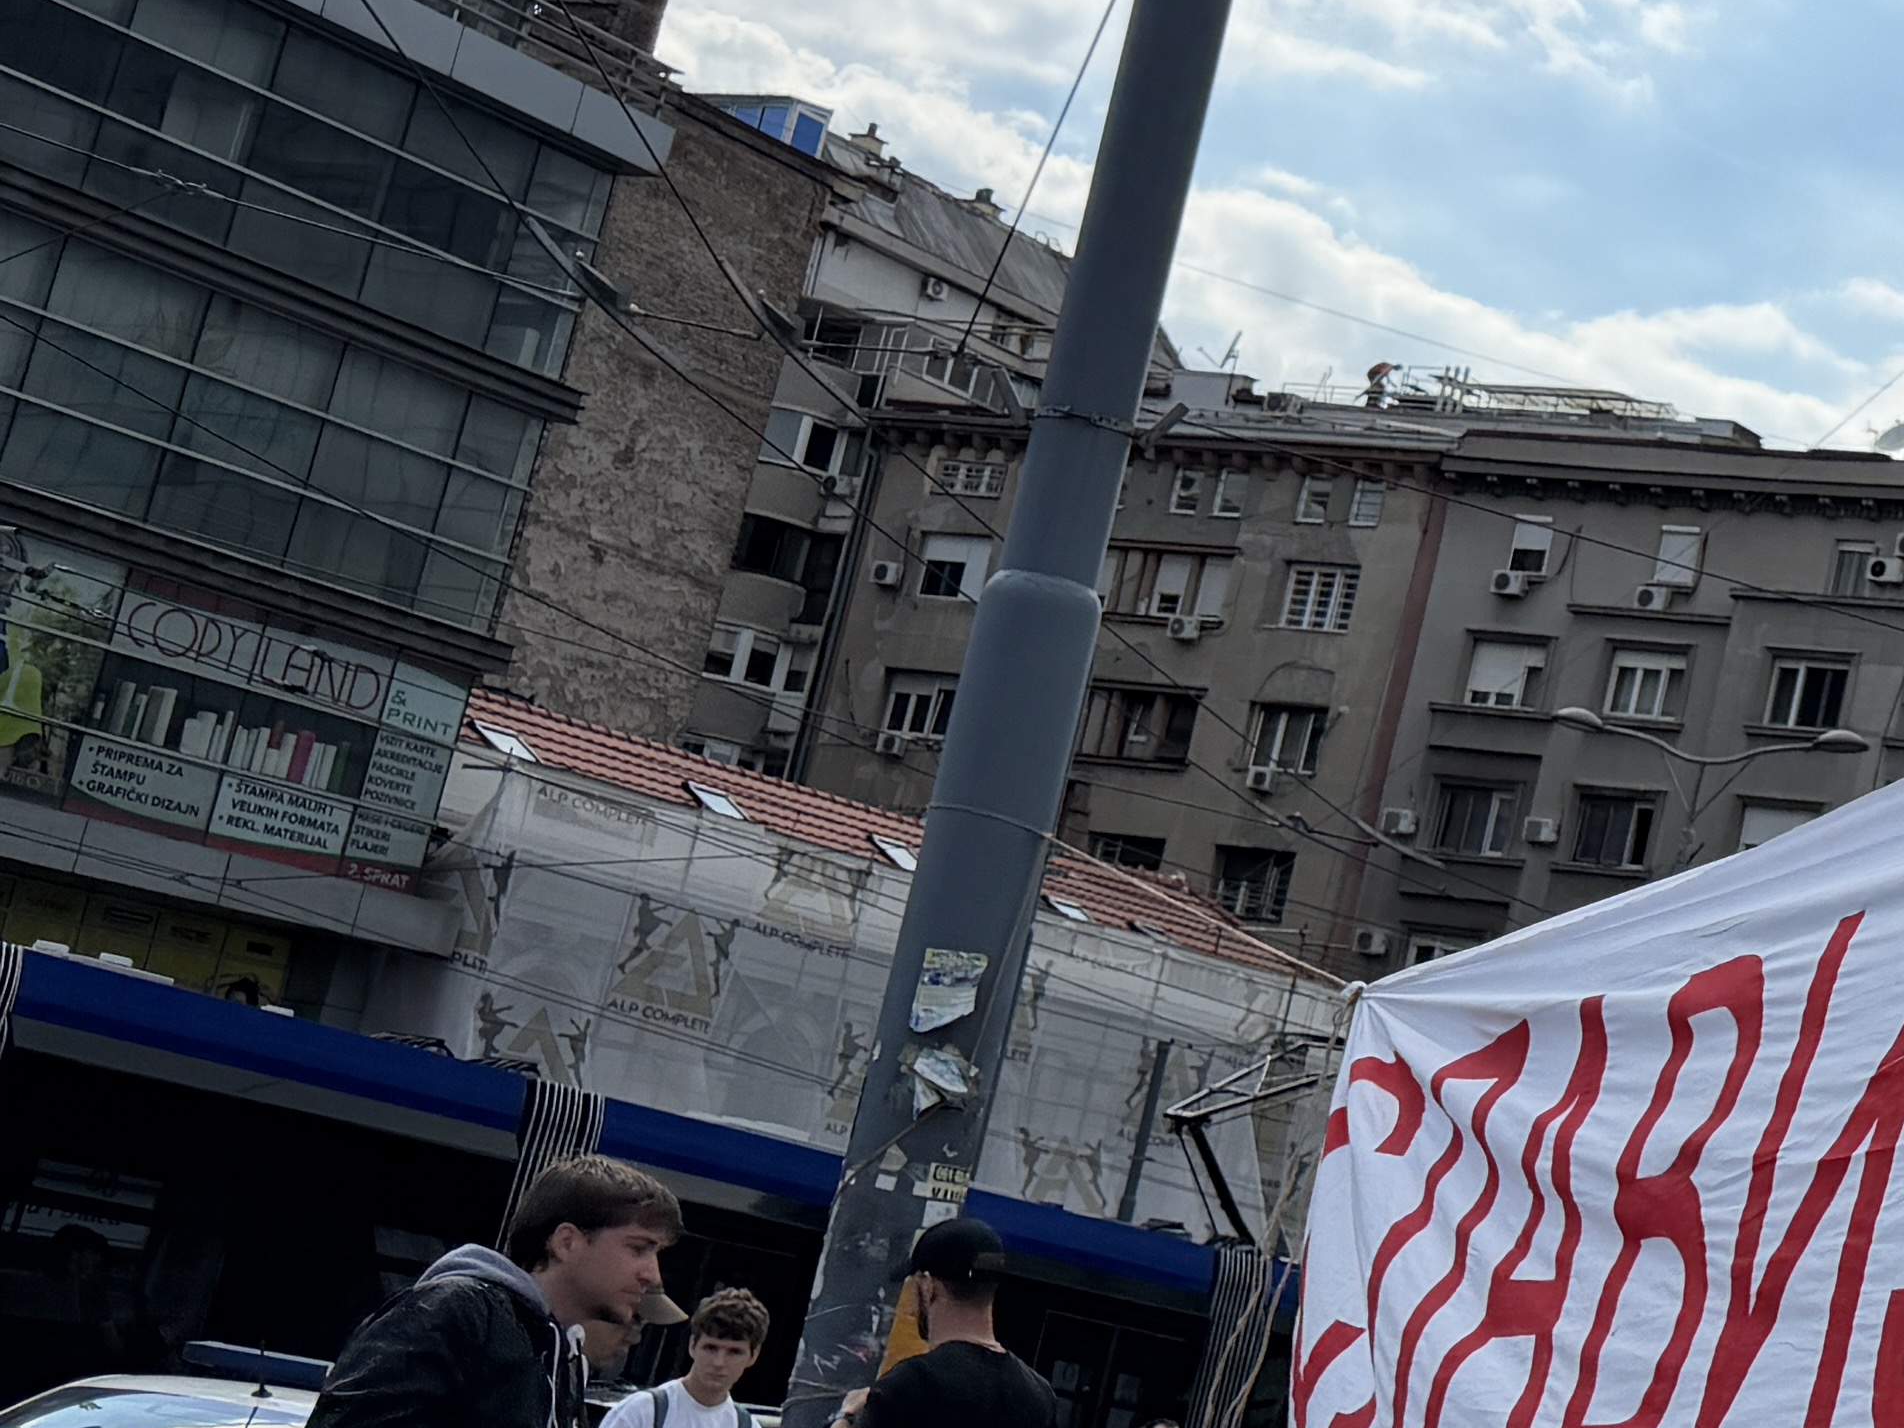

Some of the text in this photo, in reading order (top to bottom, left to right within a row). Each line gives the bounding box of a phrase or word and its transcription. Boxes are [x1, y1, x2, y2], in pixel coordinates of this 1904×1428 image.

[391, 688, 407, 706] &
[384, 708, 454, 737] PRINT
[91, 762, 146, 786] ŠTAMPU
[95, 745, 184, 777] PRIPREMA ZA
[86, 779, 200, 818] GRAFIČKI DIZAJN
[235, 779, 285, 805] ŠTAMPA
[537, 786, 568, 807] ALP
[232, 797, 340, 836] VELIKIH FORMATA
[226, 815, 328, 850] REKL. MATERIJAL
[363, 867, 411, 889] SPRAT
[607, 998, 638, 1018] ALP
